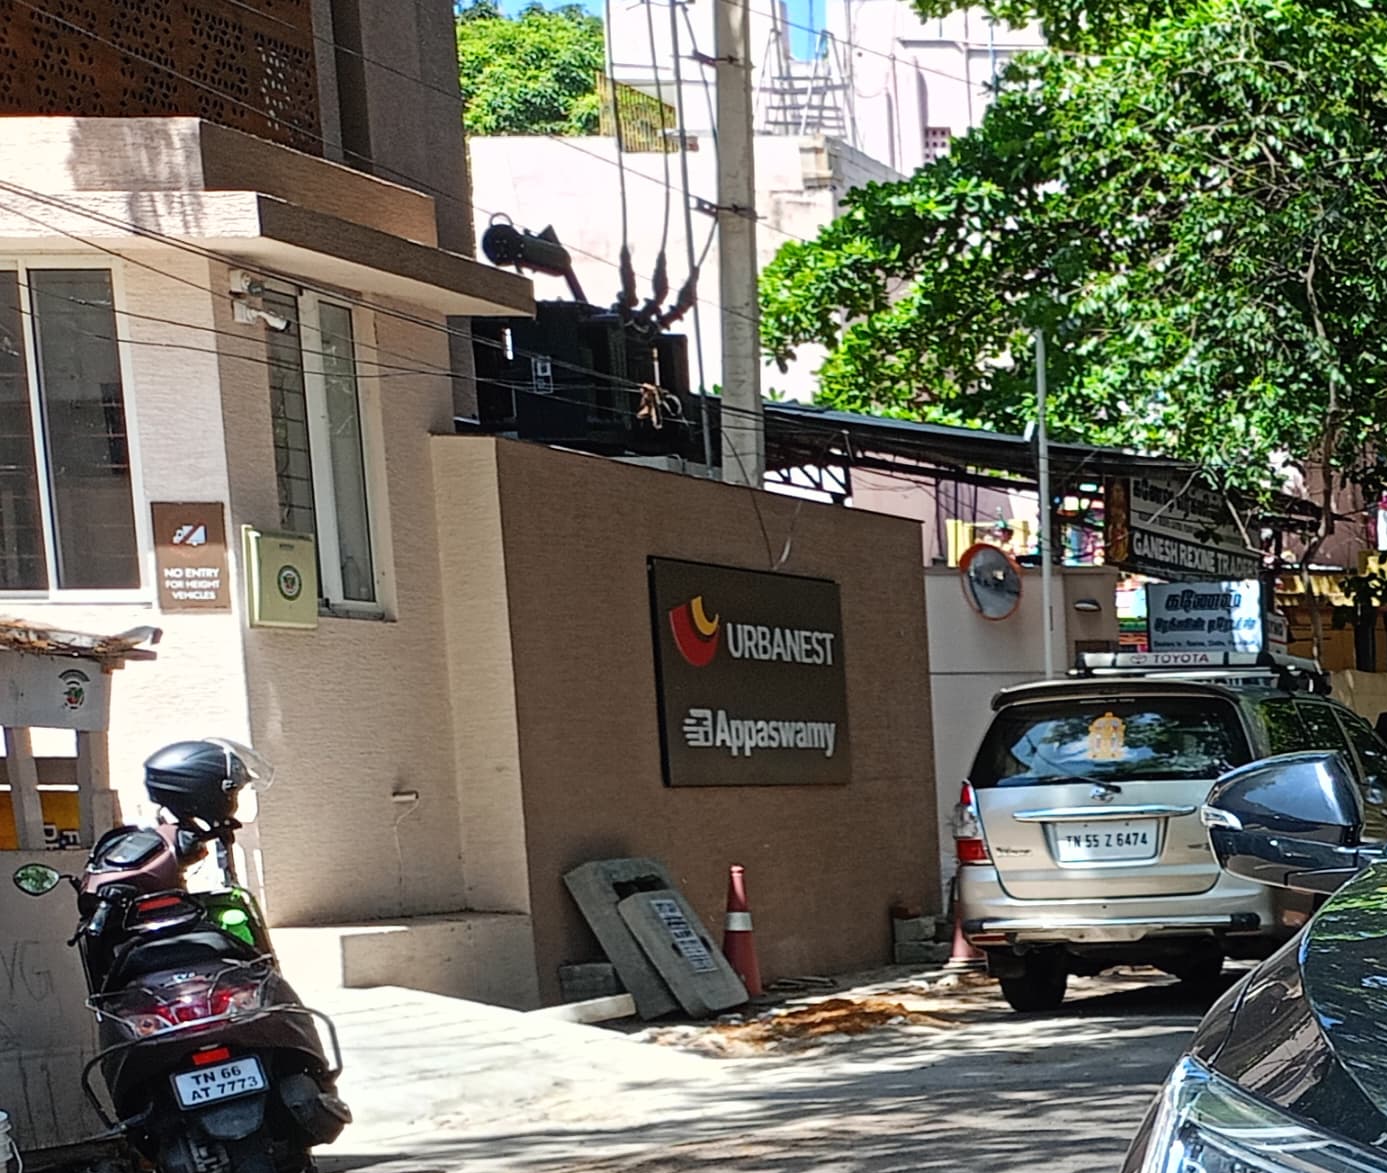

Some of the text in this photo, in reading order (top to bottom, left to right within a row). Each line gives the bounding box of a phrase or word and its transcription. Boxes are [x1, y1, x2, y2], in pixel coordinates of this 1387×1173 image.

[1132, 531, 1179, 566] GANESH
[1179, 541, 1217, 573] REXINE
[163, 567, 220, 578] NO ENTRY
[164, 580, 220, 589] FOR HEIGHT
[171, 591, 217, 600] VEHICLES
[726, 622, 835, 666] URBANEST
[1153, 653, 1210, 664] TOYOTA
[715, 709, 837, 758] Appaswamy
[1066, 832, 1148, 848] TN 55 Z 6474
[191, 1065, 242, 1085] TN 66
[191, 1075, 258, 1101] AT 7773
